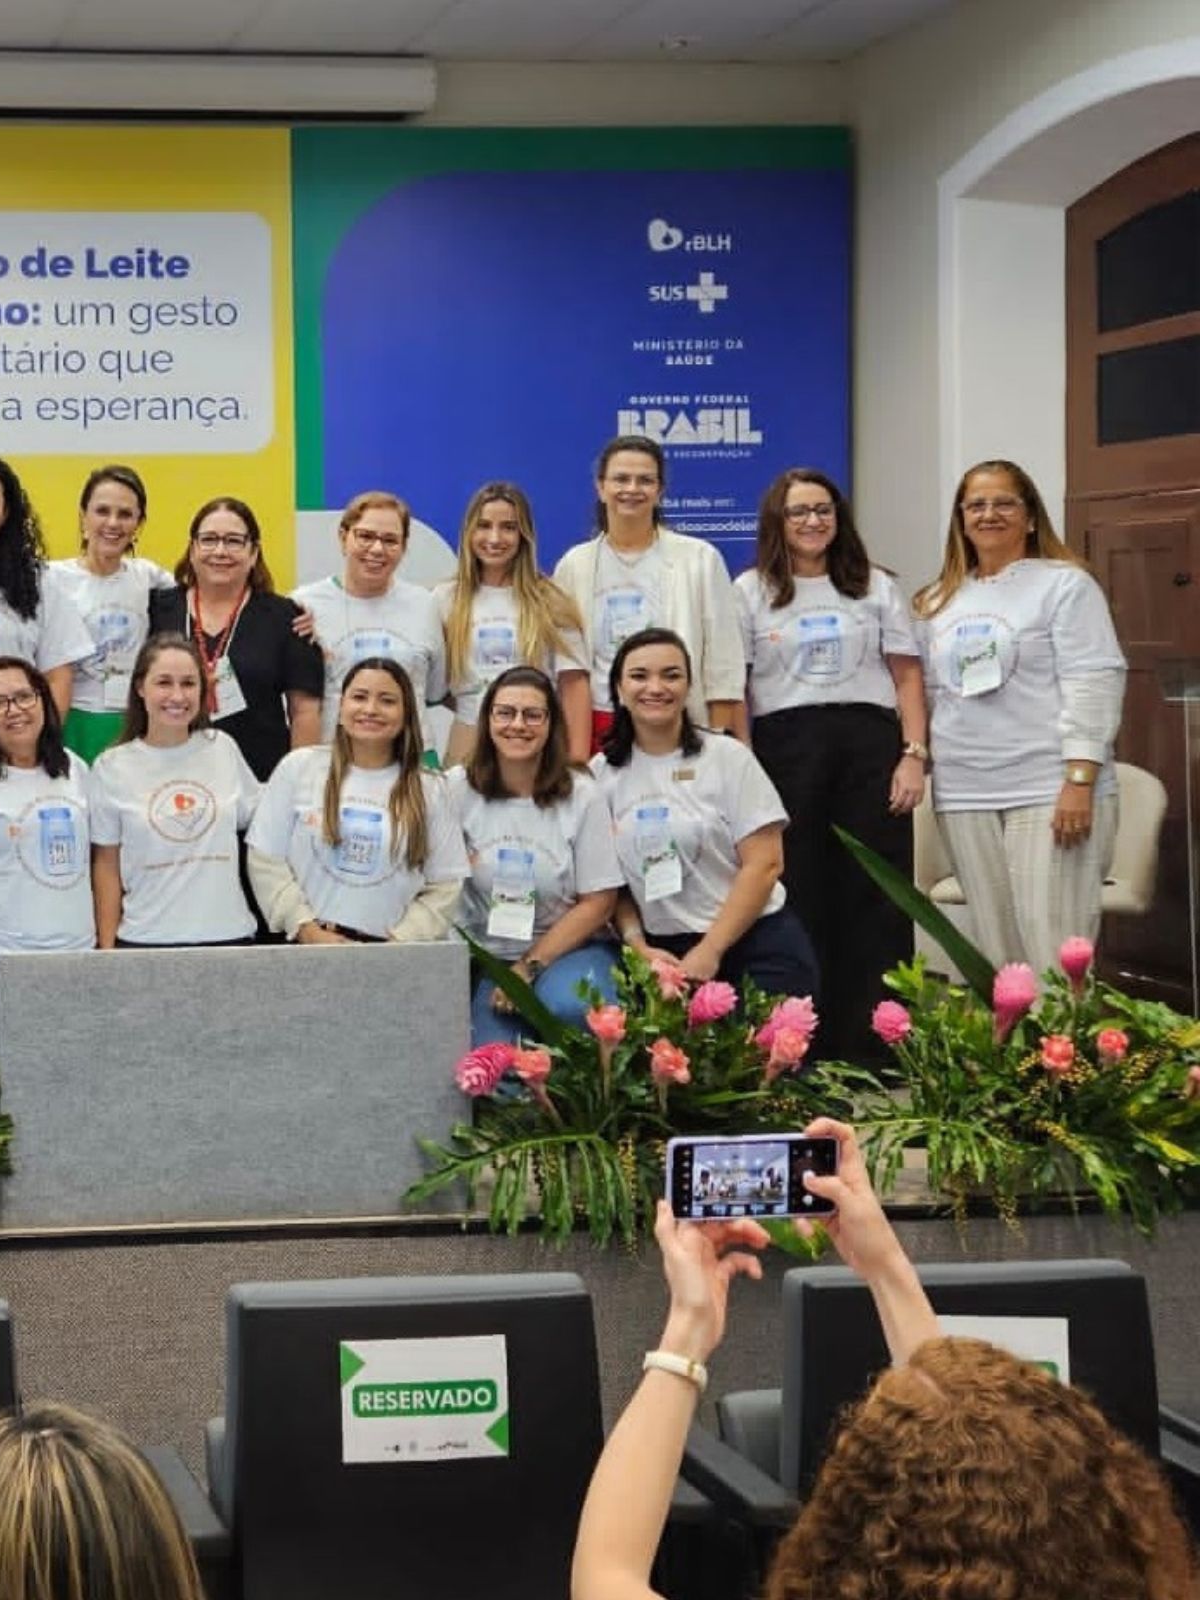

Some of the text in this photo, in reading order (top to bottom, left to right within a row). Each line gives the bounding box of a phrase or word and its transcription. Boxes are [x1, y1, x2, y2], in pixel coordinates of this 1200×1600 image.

[685, 234, 732, 251] rBLH
[20, 247, 74, 278] de
[85, 247, 191, 278] Leite
[649, 285, 684, 301] SUS
[54, 301, 115, 327] um
[129, 297, 238, 334] gesto
[724, 339, 744, 350] DA
[99, 348, 174, 381] que
[35, 395, 248, 429] esperança.
[629, 394, 749, 405] GOVERNO FEDERAL
[617, 407, 763, 445] BRASIL
[357, 1386, 492, 1412] RESERVADO
